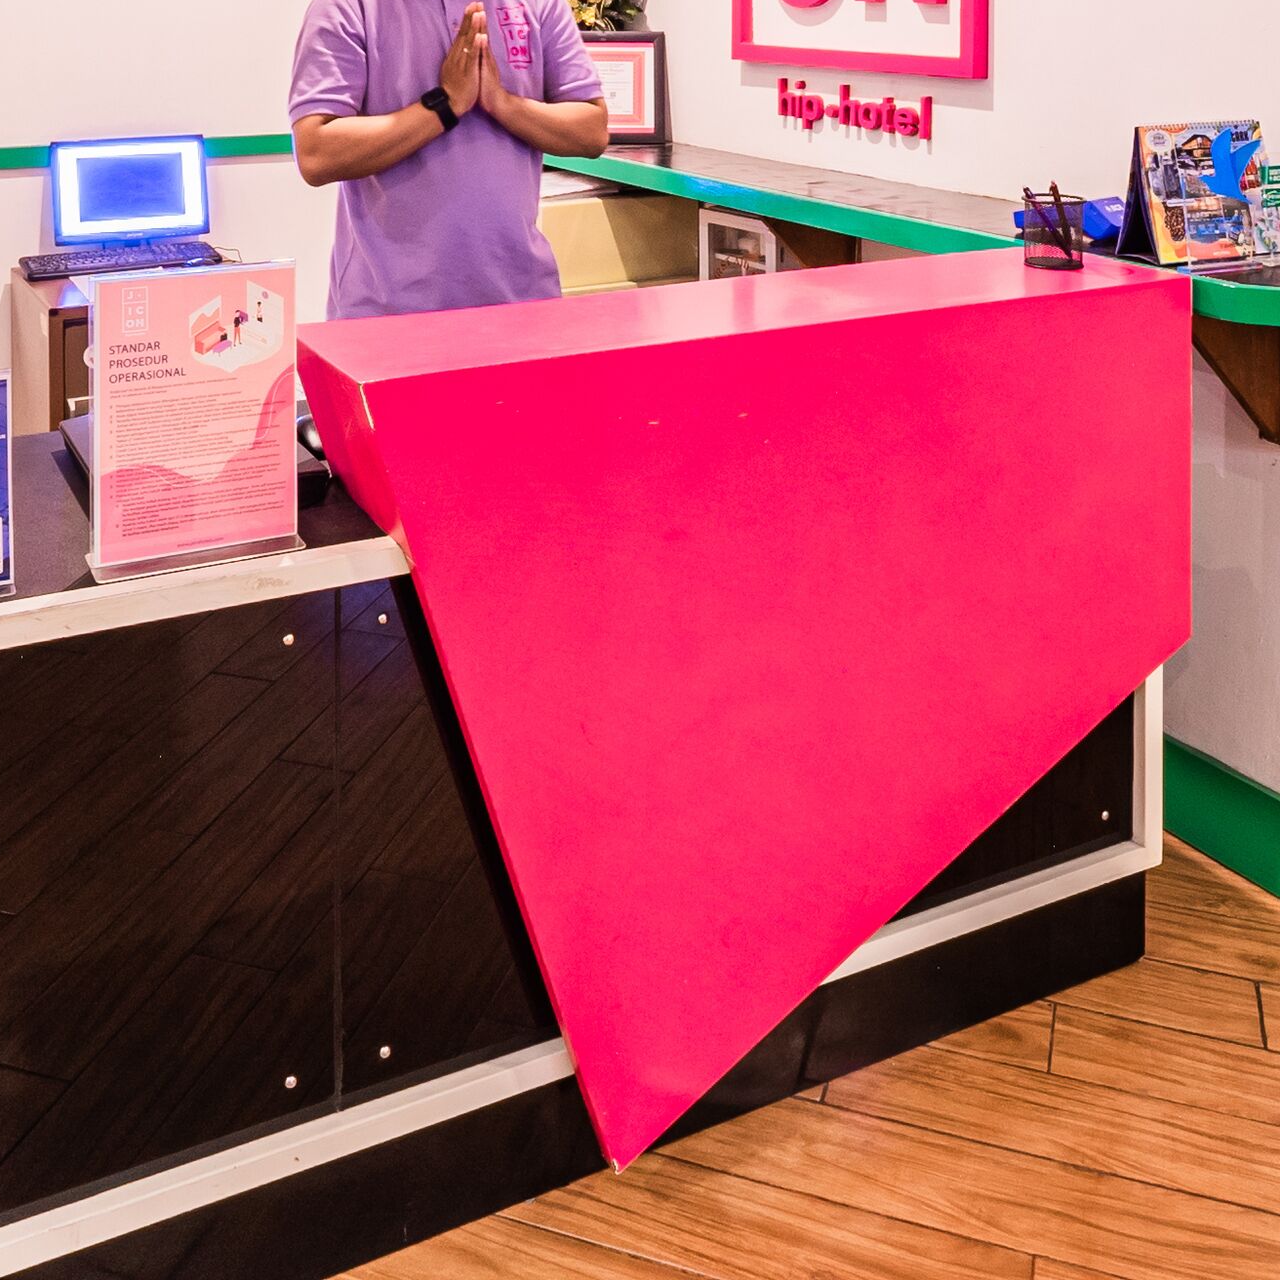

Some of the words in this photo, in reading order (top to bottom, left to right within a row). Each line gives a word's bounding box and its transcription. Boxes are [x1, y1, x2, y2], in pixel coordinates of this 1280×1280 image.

[778, 78, 932, 140] hip-hotel
[109, 340, 161, 355] STANDAR
[109, 354, 169, 369] PROSEDUR
[109, 367, 187, 384] OPERASIONAL
